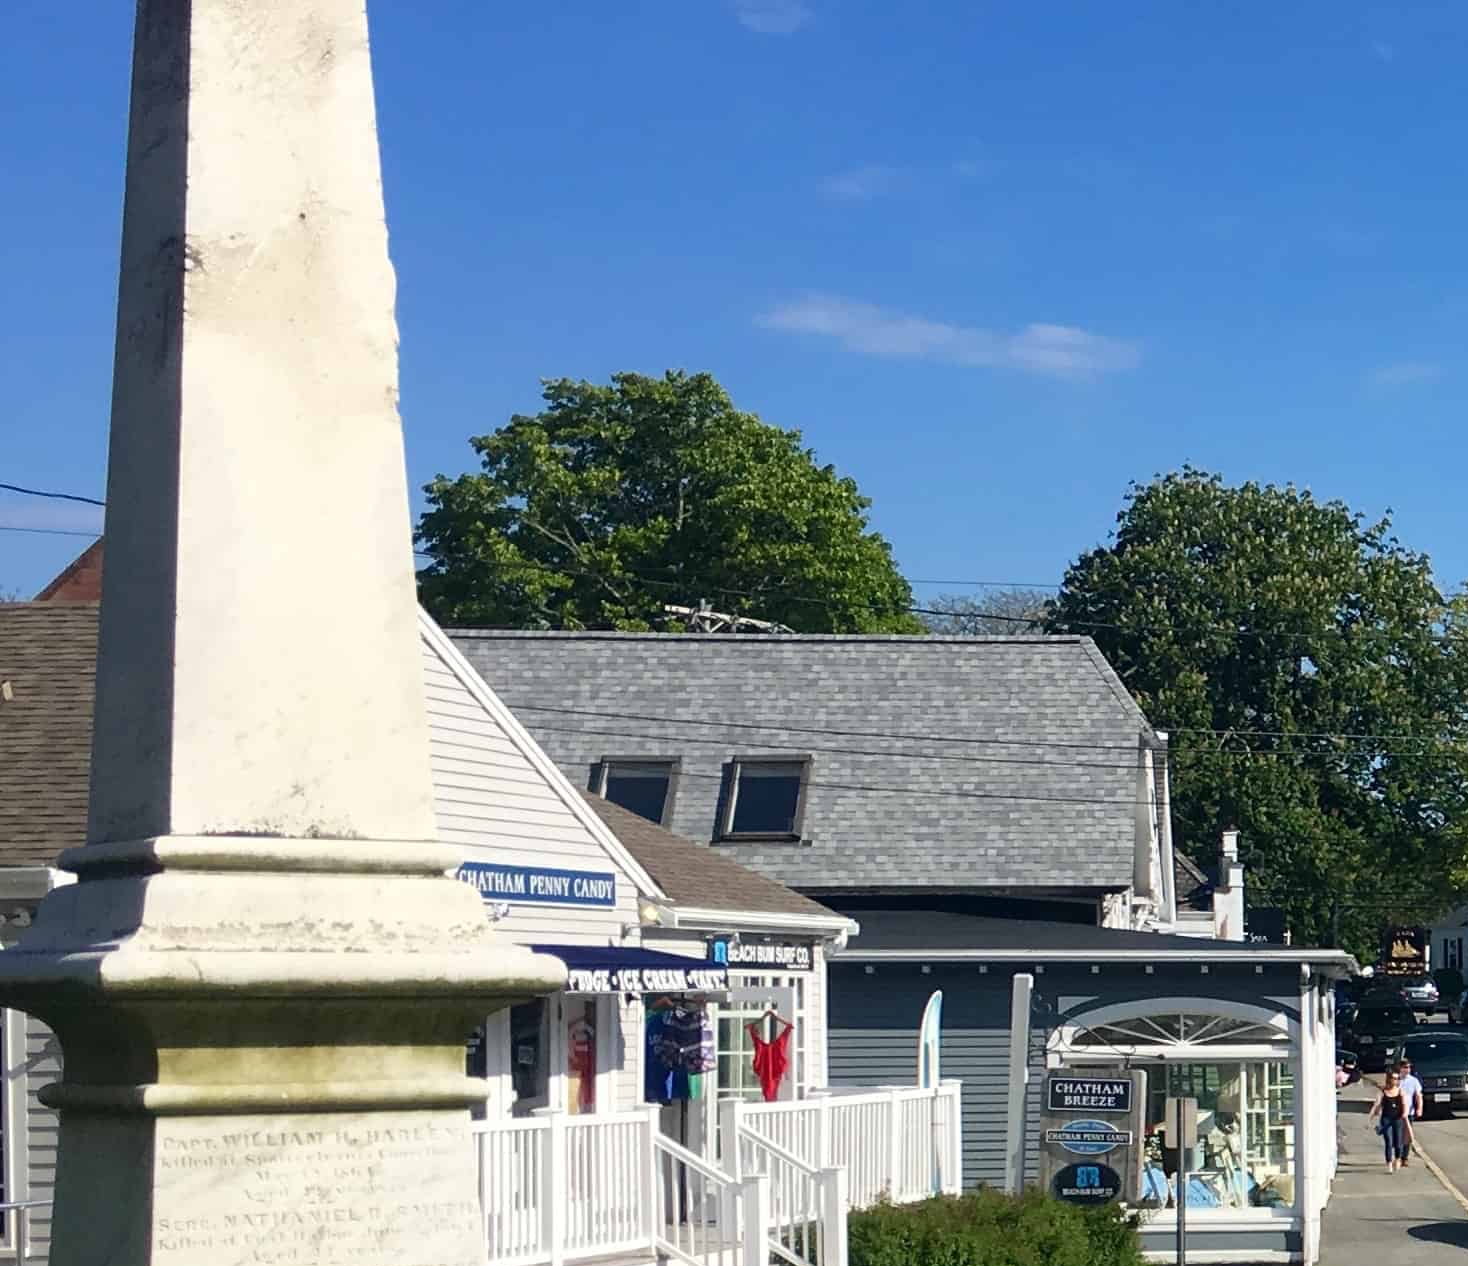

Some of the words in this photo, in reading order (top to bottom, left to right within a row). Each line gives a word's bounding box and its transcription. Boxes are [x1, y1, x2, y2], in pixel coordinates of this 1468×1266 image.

[530, 875, 571, 897] PENNY
[574, 878, 614, 900] CANDY
[776, 946, 795, 964] SURF
[617, 970, 643, 991] ICE
[643, 969, 689, 991] CREAM
[1055, 1083, 1125, 1095] CHATHAM
[1064, 1095, 1116, 1106] BREEZE
